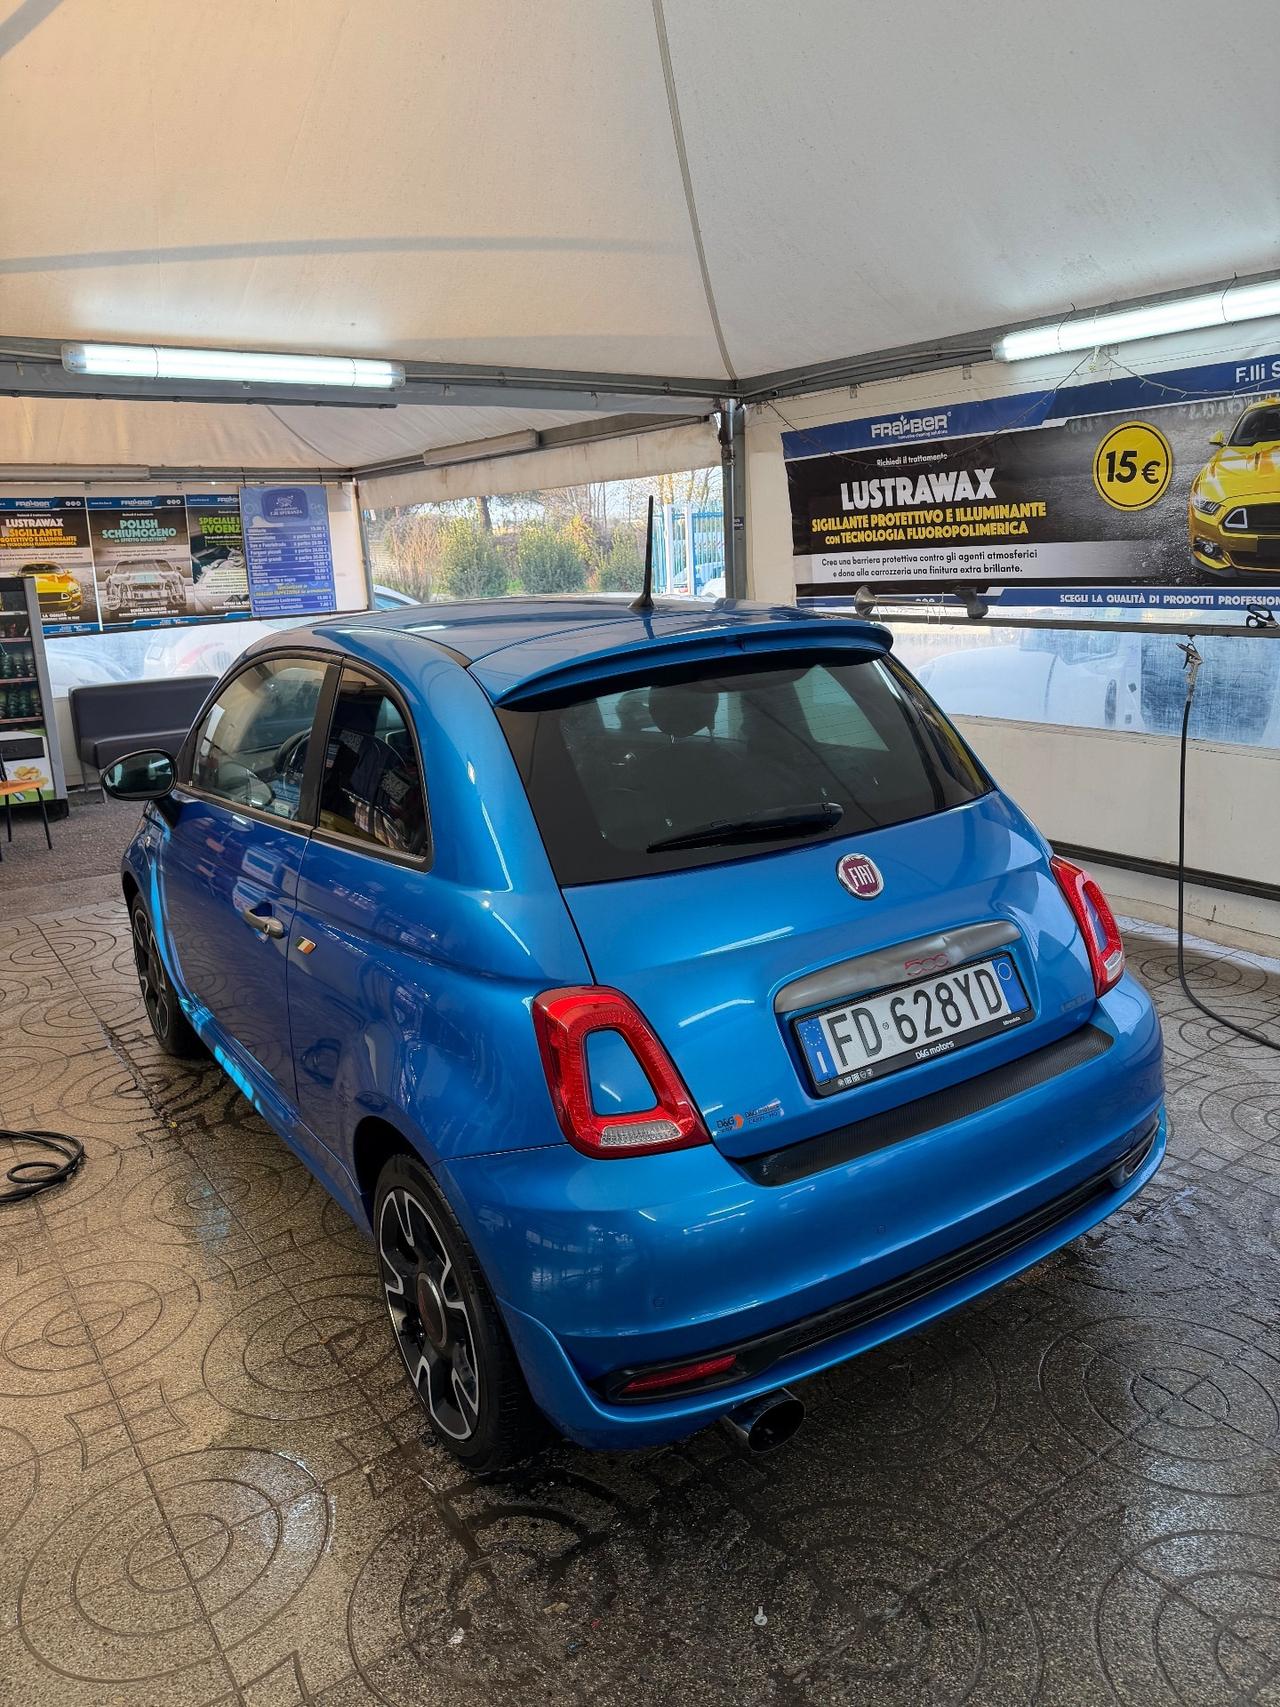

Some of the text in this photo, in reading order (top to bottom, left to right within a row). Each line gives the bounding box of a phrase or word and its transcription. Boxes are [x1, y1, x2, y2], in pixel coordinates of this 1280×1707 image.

[1236, 363, 1266, 384] F.lli
[877, 453, 948, 466] Richiedi il trattamento
[1106, 450, 1162, 484] 15 €
[840, 468, 997, 510] LUSTRAWAX
[6, 518, 64, 528] LUSTRAWAX
[120, 519, 158, 529] POLISH
[812, 502, 1047, 532] SIGILLANTE PROTETTIVO E ILLUMINANTE
[9, 528, 63, 537] SIGILLANTE
[102, 528, 176, 538] SCHIUMOGENO
[841, 528, 906, 544] TECNOLOGIA
[907, 520, 1028, 540] FLUOROPOLIMERICA
[822, 558, 838, 566] Crea
[852, 555, 880, 565] barriera
[882, 554, 918, 566] protettiva
[920, 553, 944, 562] contro
[946, 551, 956, 564] gli
[958, 551, 985, 563] agenti
[986, 549, 1038, 560] atmosferici
[856, 568, 870, 576] alla
[870, 567, 912, 576] carrozzeria
[929, 565, 958, 574] finitura
[960, 565, 982, 574] extra
[984, 563, 1022, 573] brillante.
[1060, 594, 1088, 603] SCEGLI
[1092, 594, 1102, 603] LA
[1106, 592, 1145, 604] QUALITÀ
[1149, 595, 1160, 604] DI
[1163, 595, 1214, 605] PRODOTTI
[848, 864, 875, 890] FIAT
[827, 968, 1002, 1067] FD 628YD
[915, 1041, 954, 1060] D&G motors
